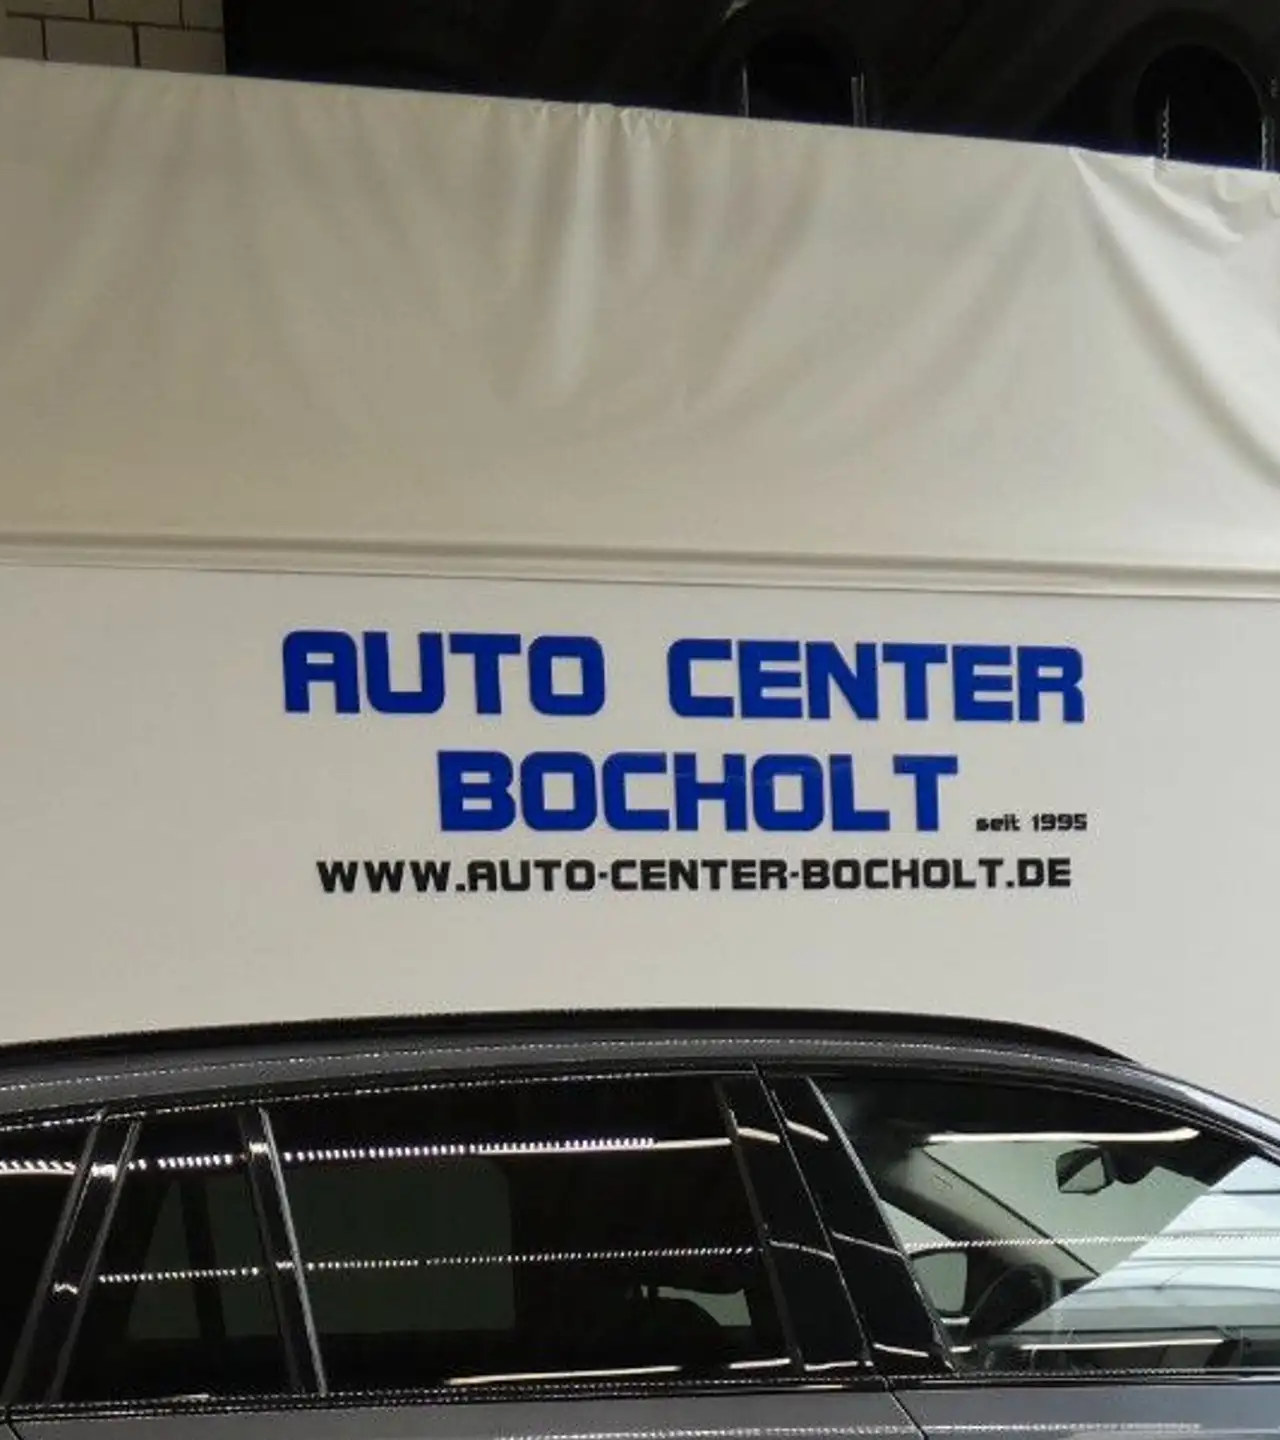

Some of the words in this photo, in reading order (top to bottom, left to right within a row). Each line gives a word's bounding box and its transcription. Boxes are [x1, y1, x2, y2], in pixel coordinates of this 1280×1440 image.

[282, 630, 607, 717] AUTO
[666, 638, 1086, 724] CENTER
[436, 750, 960, 834] BOCHOLT
[975, 814, 1021, 833] seit
[1031, 812, 1088, 832] 1995
[315, 857, 1073, 894] WWW.AUTO-CENTER-BOCHOLT.DE
